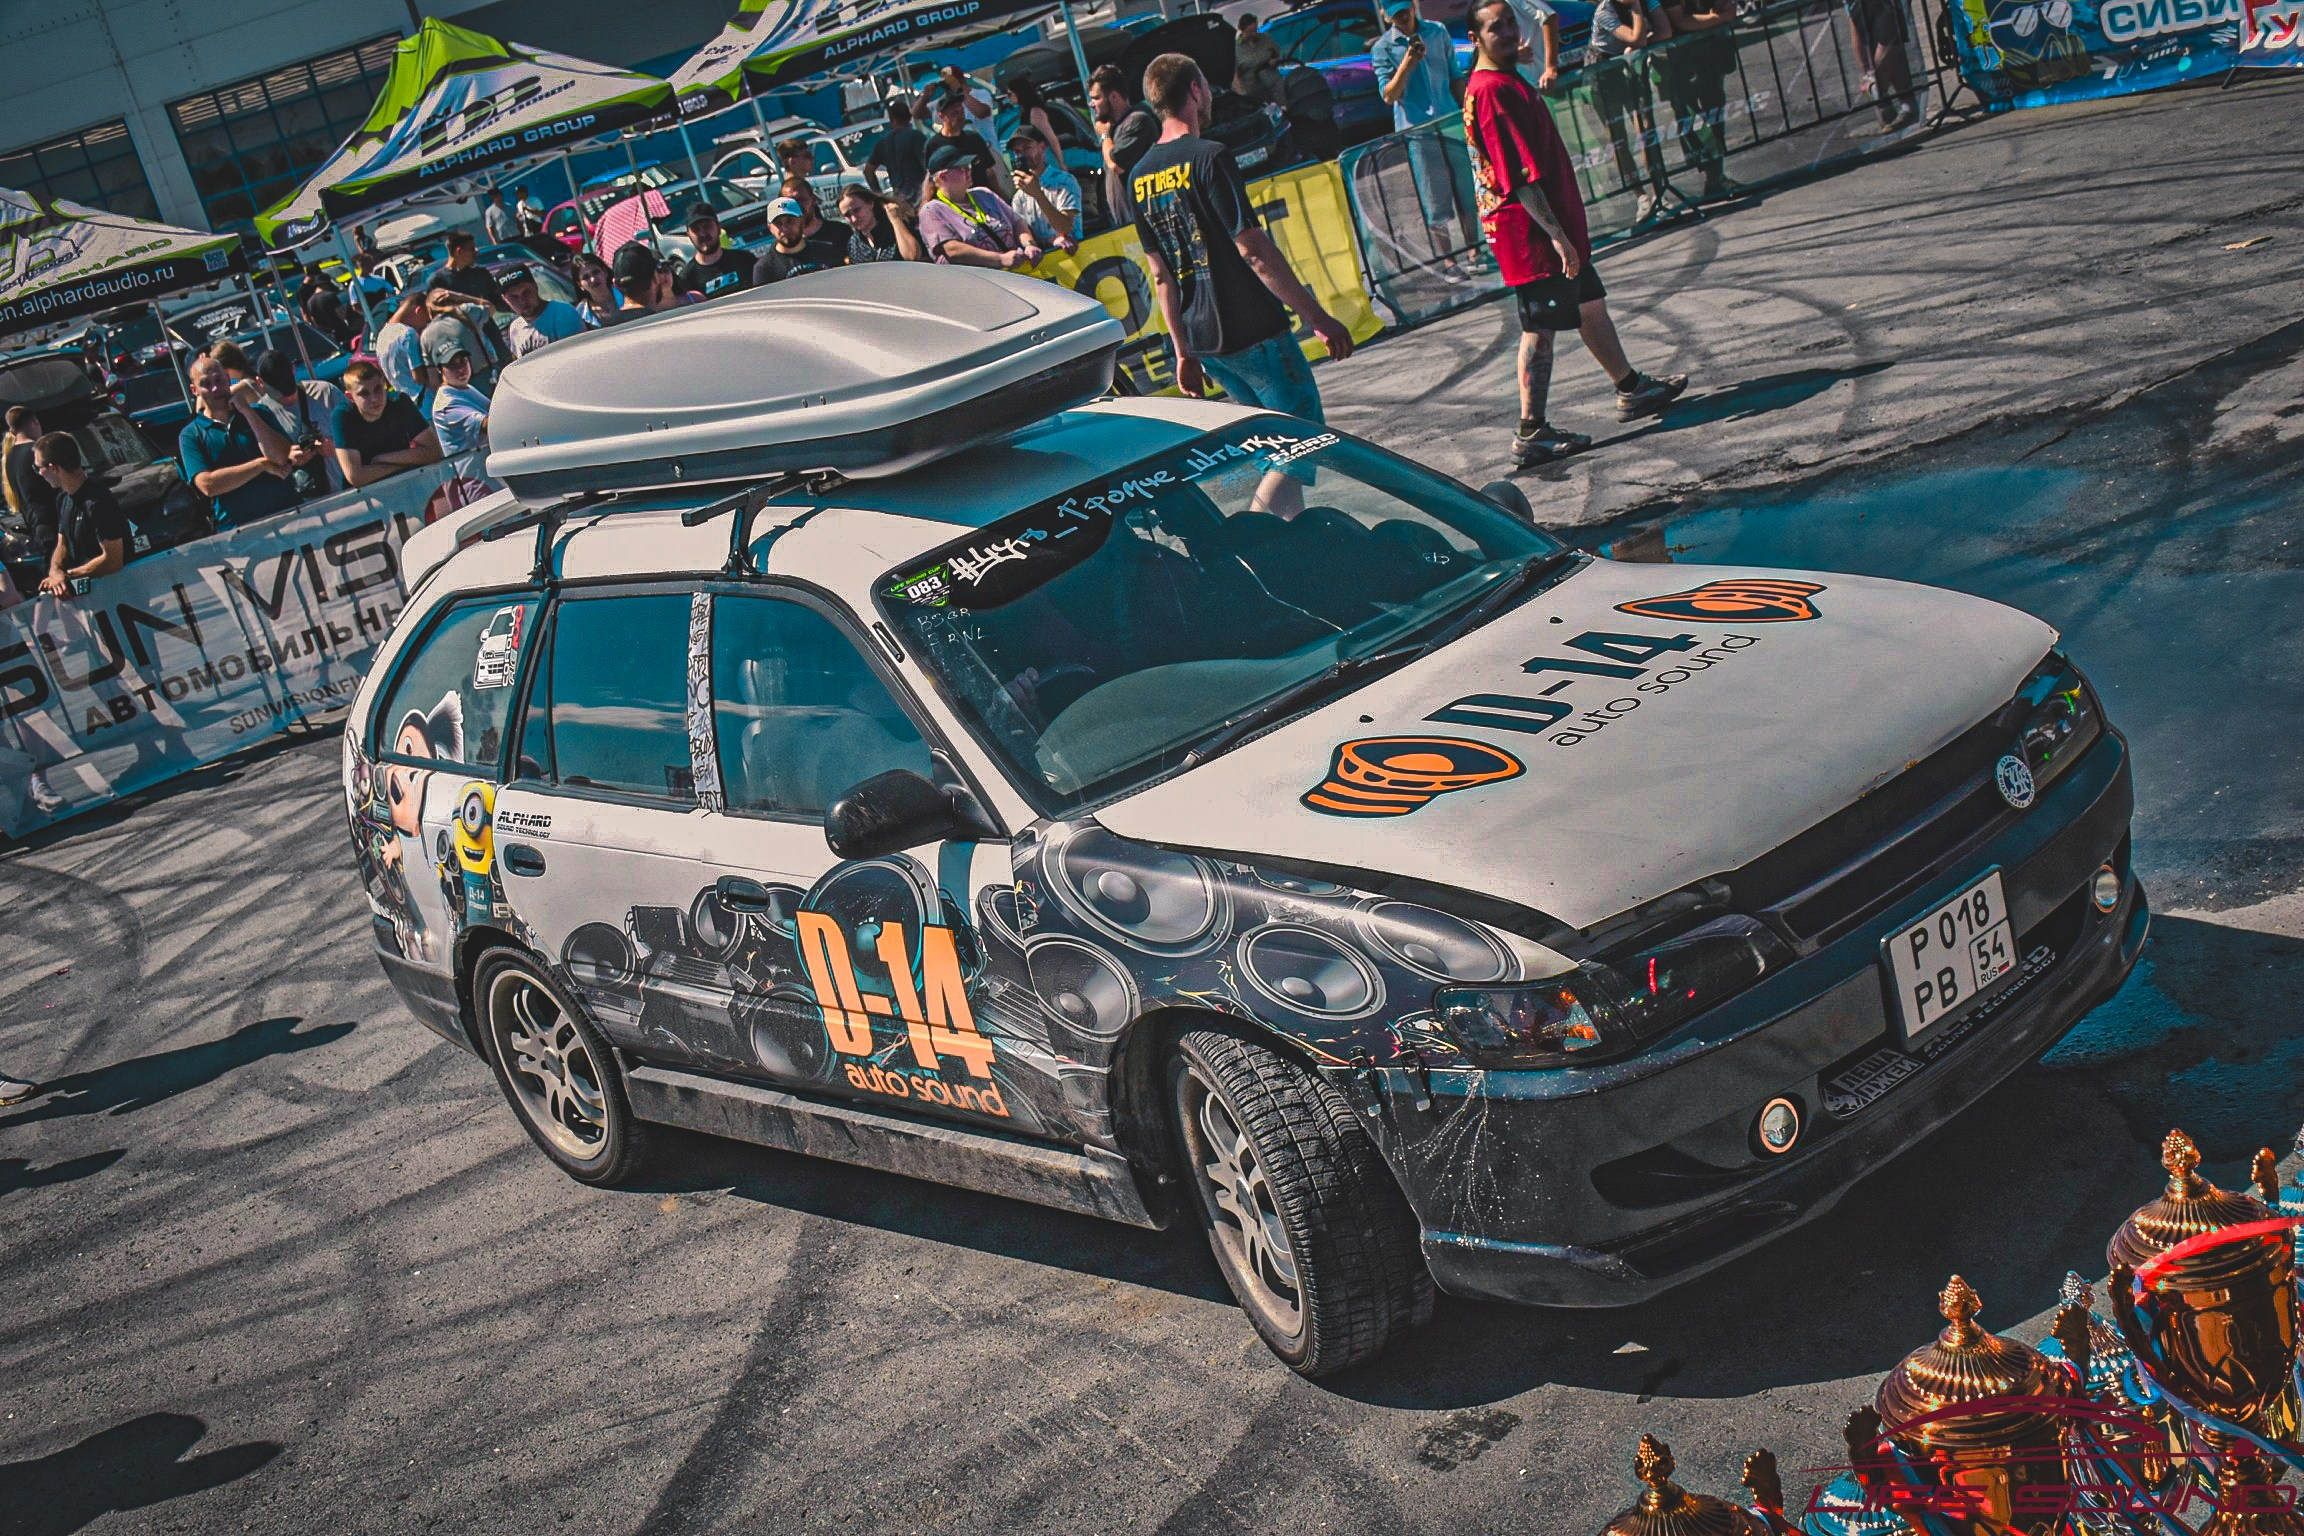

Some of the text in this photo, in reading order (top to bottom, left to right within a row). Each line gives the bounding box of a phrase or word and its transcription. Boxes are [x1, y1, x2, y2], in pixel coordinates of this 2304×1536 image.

[823, 20, 911, 61] ALPHARD
[915, 1, 981, 28] GROUP
[419, 135, 516, 178] ALPHARD
[523, 113, 598, 143] GROUP
[907, 576, 942, 599] 083
[927, 566, 941, 575] CUP
[0, 582, 203, 720] SUN
[229, 672, 362, 737] SUNVISIONFI
[1421, 630, 1703, 735] D-14
[1547, 632, 1762, 749] auto sound
[497, 811, 552, 828] ALPHARD
[1938, 889, 1990, 951] 018
[1975, 937, 2006, 971] 54
[1980, 966, 1999, 986] RUS
[796, 911, 997, 1079] D-14
[1927, 1021, 1974, 1060] SOUND
[1975, 951, 2057, 1020] TECHNOLOGY
[844, 1061, 1011, 1118] auto sound
